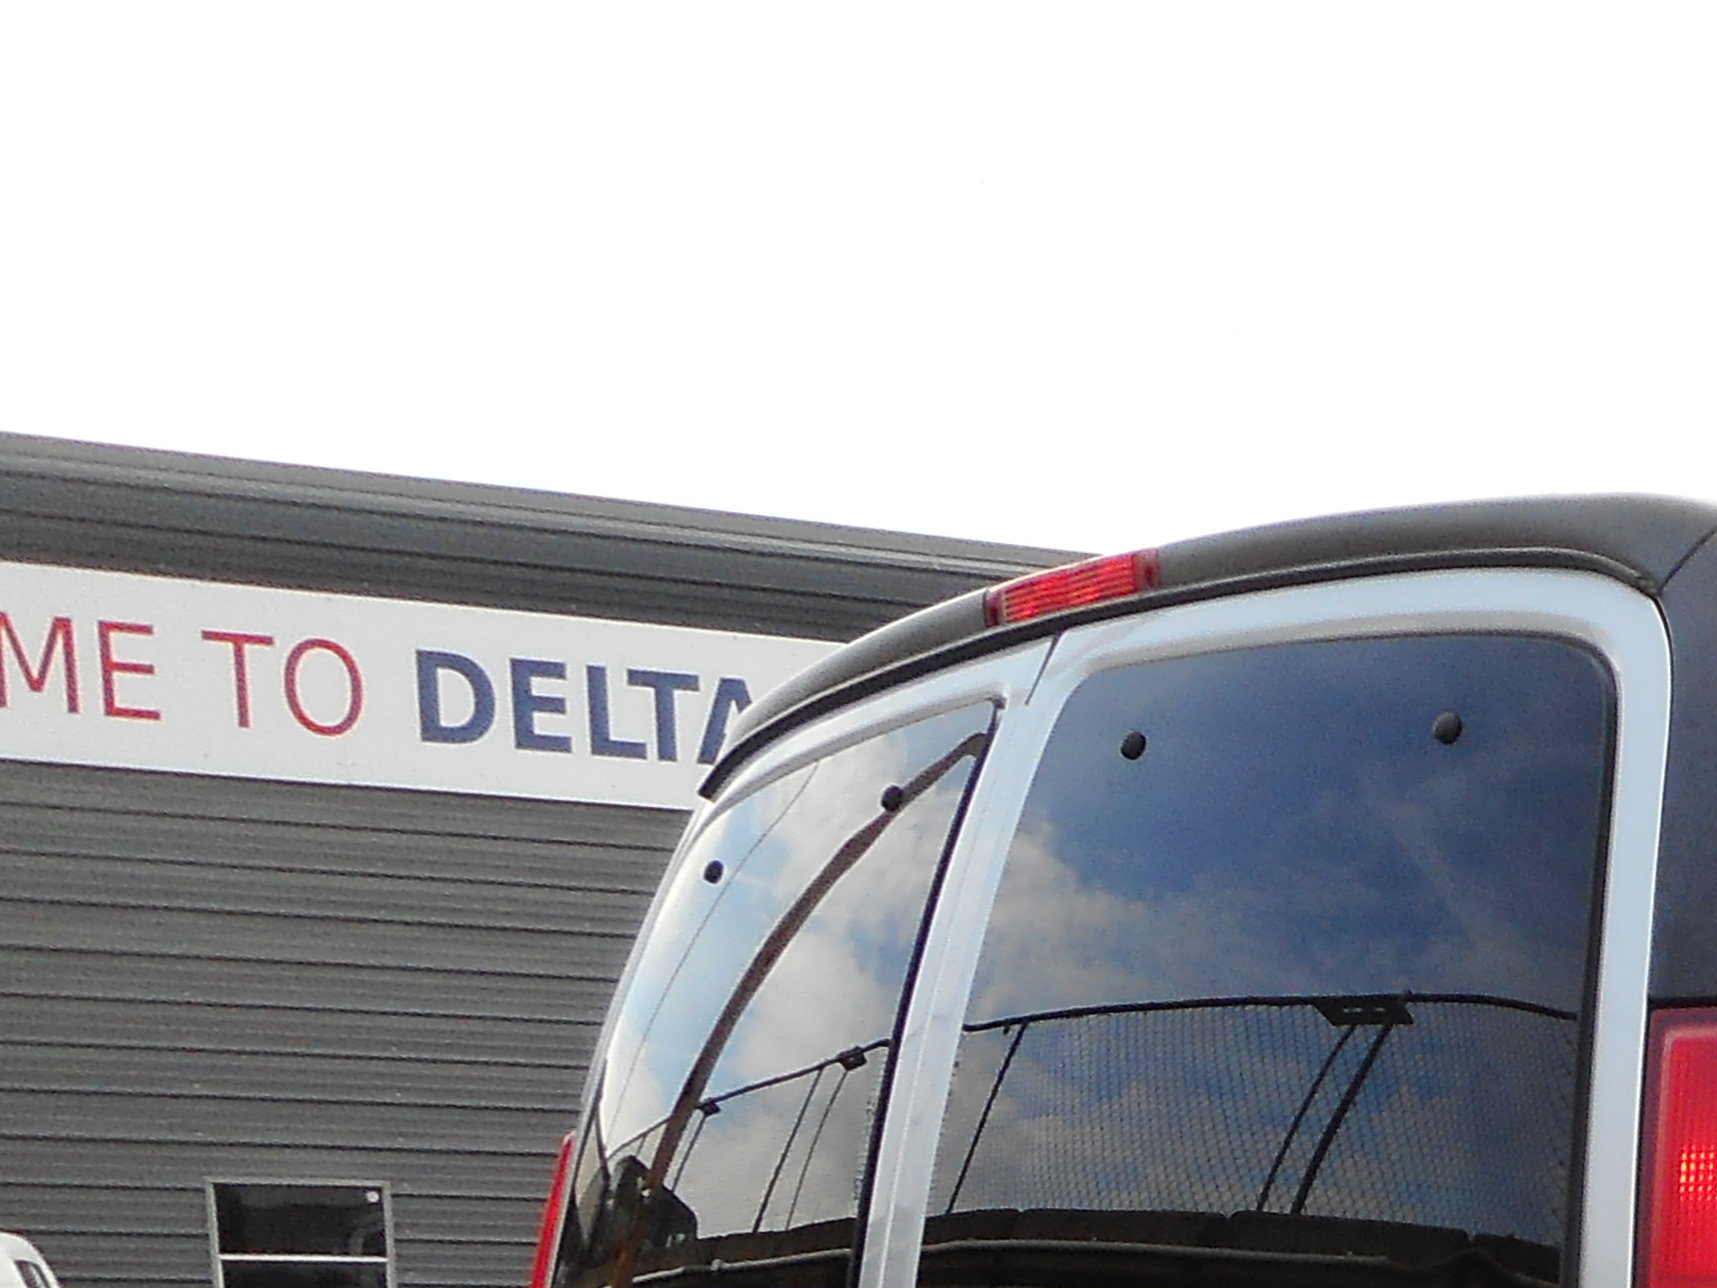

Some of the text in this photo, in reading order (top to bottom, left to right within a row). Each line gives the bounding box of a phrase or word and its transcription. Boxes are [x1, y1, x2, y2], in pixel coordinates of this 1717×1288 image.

[0, 611, 753, 765] ME TO DELTA
